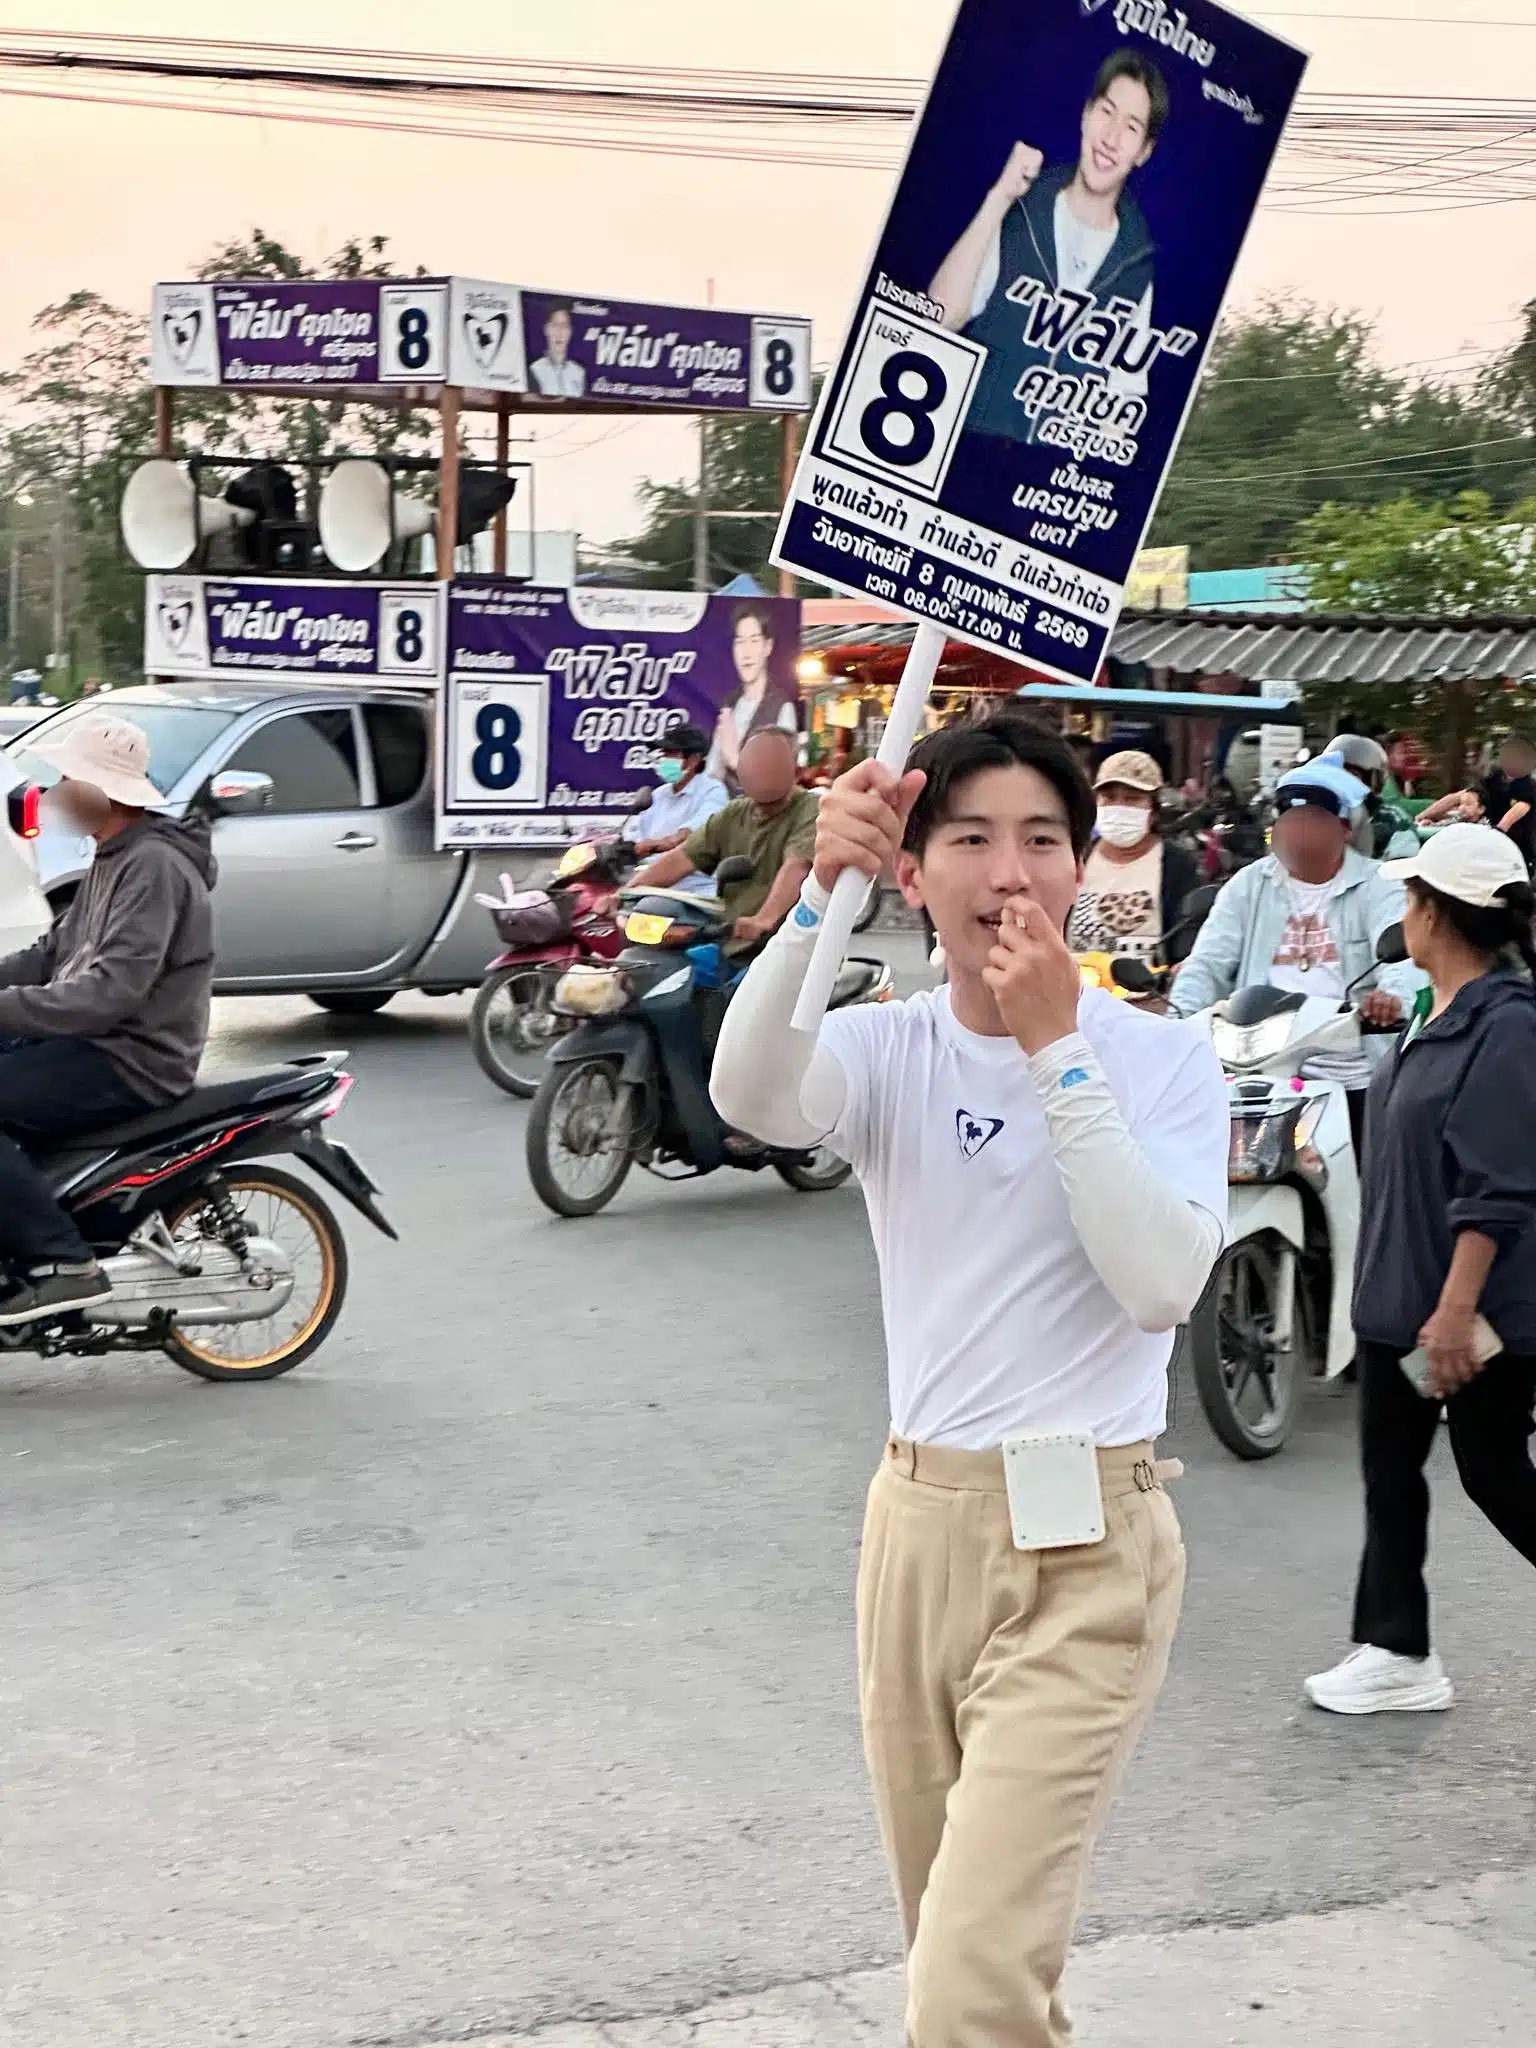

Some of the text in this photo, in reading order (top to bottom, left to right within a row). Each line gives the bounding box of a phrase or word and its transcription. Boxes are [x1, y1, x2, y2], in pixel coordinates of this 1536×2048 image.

[399, 307, 430, 369] 8
[765, 338, 794, 395] 8
[876, 323, 914, 347] เบอร์
[860, 351, 947, 466] 8
[1013, 365, 1147, 436] ศุภโชค
[1012, 484, 1118, 531] นครปฐม
[812, 474, 1110, 614] พูดแล้วทำ ทำแล้วดี ดีแล้วทำต่อ
[812, 516, 1089, 648] วันอาทิตย์ที่ 8 กุมภาพันธ์ 2569
[865, 573, 1022, 650] เวลา 08.00-17.00 น.
[396, 609, 424, 662] 8
[472, 702, 521, 790] 8
